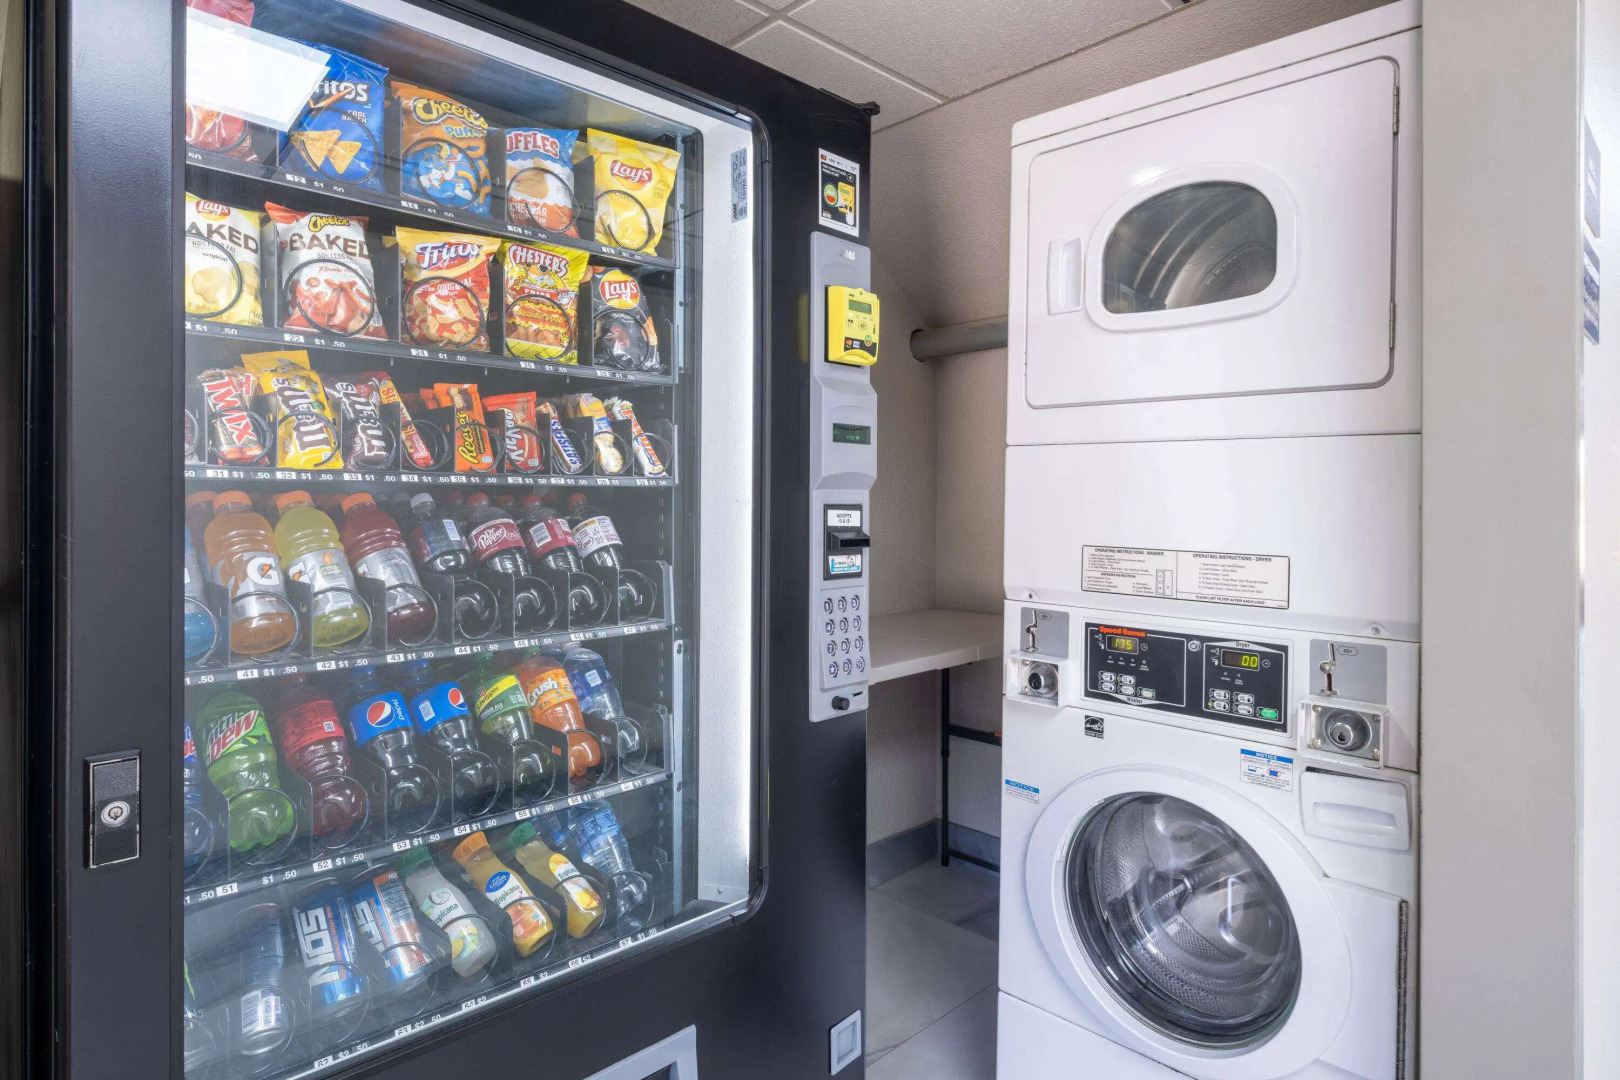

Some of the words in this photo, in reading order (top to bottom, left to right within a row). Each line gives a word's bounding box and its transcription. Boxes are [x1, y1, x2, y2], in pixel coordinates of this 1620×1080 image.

[315, 80, 368, 102] ritos
[506, 131, 560, 158] UFFLES
[612, 162, 651, 182] Lay's
[308, 215, 351, 233] Cheetos
[186, 221, 259, 254] AKED
[414, 241, 482, 270] Fritos
[508, 244, 569, 277] CHESTER'S
[604, 280, 637, 300] Lay's
[202, 374, 257, 444] TWIX
[457, 411, 480, 464] Reese's
[301, 472, 312, 480] $1
[479, 527, 504, 549] Pepper
[485, 527, 496, 538] Dr
[1100, 625, 1121, 635] Speed
[1122, 628, 1146, 638] Queen
[472, 645, 481, 653] $1
[407, 652, 416, 660] $1
[1241, 655, 1258, 668] 00
[283, 666, 298, 674] .50
[338, 660, 349, 668] $1
[198, 675, 214, 684] .50
[527, 677, 559, 706] Crush
[1126, 696, 1143, 704] Washer
[391, 699, 406, 721] pepsi
[1255, 751, 1278, 761] NOTICE
[583, 794, 591, 802] $1
[532, 807, 540, 815] $1
[472, 821, 481, 831] $1
[485, 819, 497, 828] .50
[412, 836, 422, 846] $1
[427, 833, 440, 842] .50
[336, 857, 346, 865] $1
[351, 853, 365, 862] .50
[262, 875, 274, 884] $1
[282, 870, 297, 879] .50
[198, 891, 215, 901] .50
[494, 884, 521, 906] Tropicana
[433, 902, 459, 925] opicana
[477, 996, 487, 1005] $2
[415, 1020, 425, 1029] $2
[338, 1050, 350, 1059] $2
